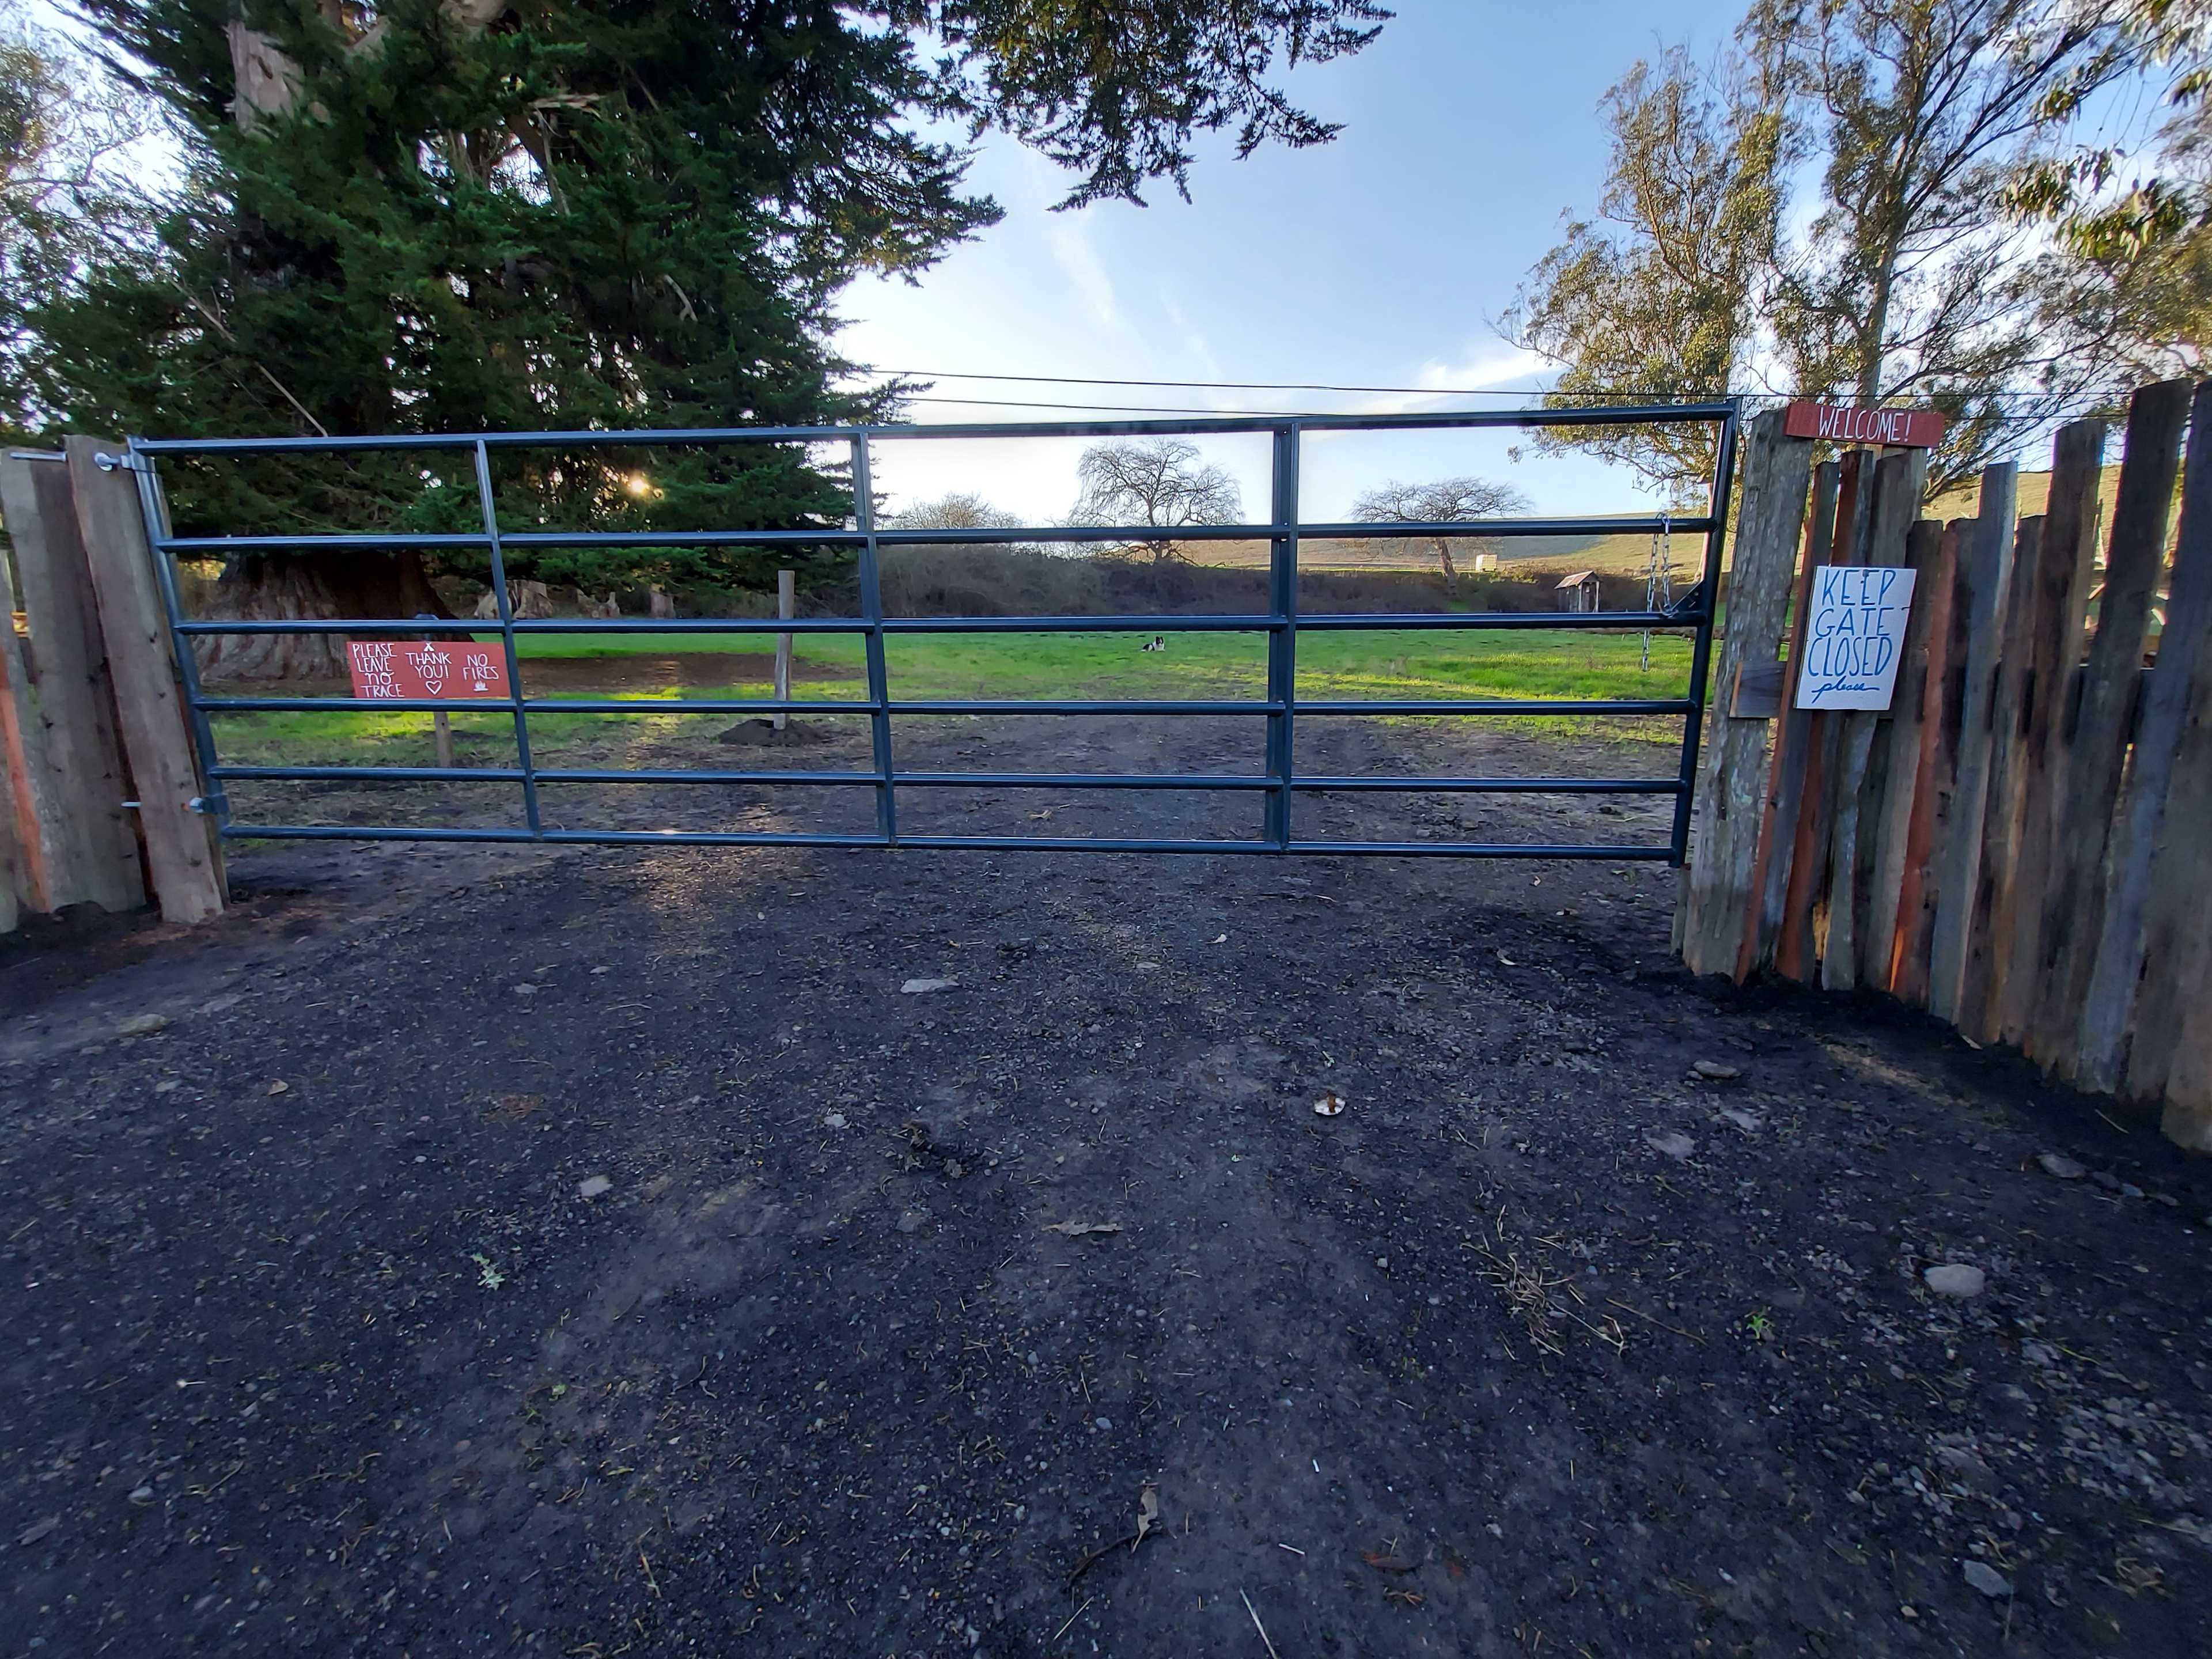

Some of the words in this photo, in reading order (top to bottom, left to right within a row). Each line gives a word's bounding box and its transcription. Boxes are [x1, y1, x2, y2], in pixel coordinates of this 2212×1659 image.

[1819, 406, 1912, 442] WELCOME!
[1822, 569, 1896, 605] KEEP
[1815, 607, 1895, 637] GATE
[352, 643, 397, 658] PLEASE
[1808, 637, 1892, 676] CLOSED
[356, 657, 394, 673] LEAVE
[405, 652, 452, 665] THANK
[467, 653, 488, 667] NO
[414, 665, 449, 679] YOU!
[463, 666, 499, 680] FIRES
[361, 684, 405, 698] TRACE
[1811, 675, 1880, 704] please
